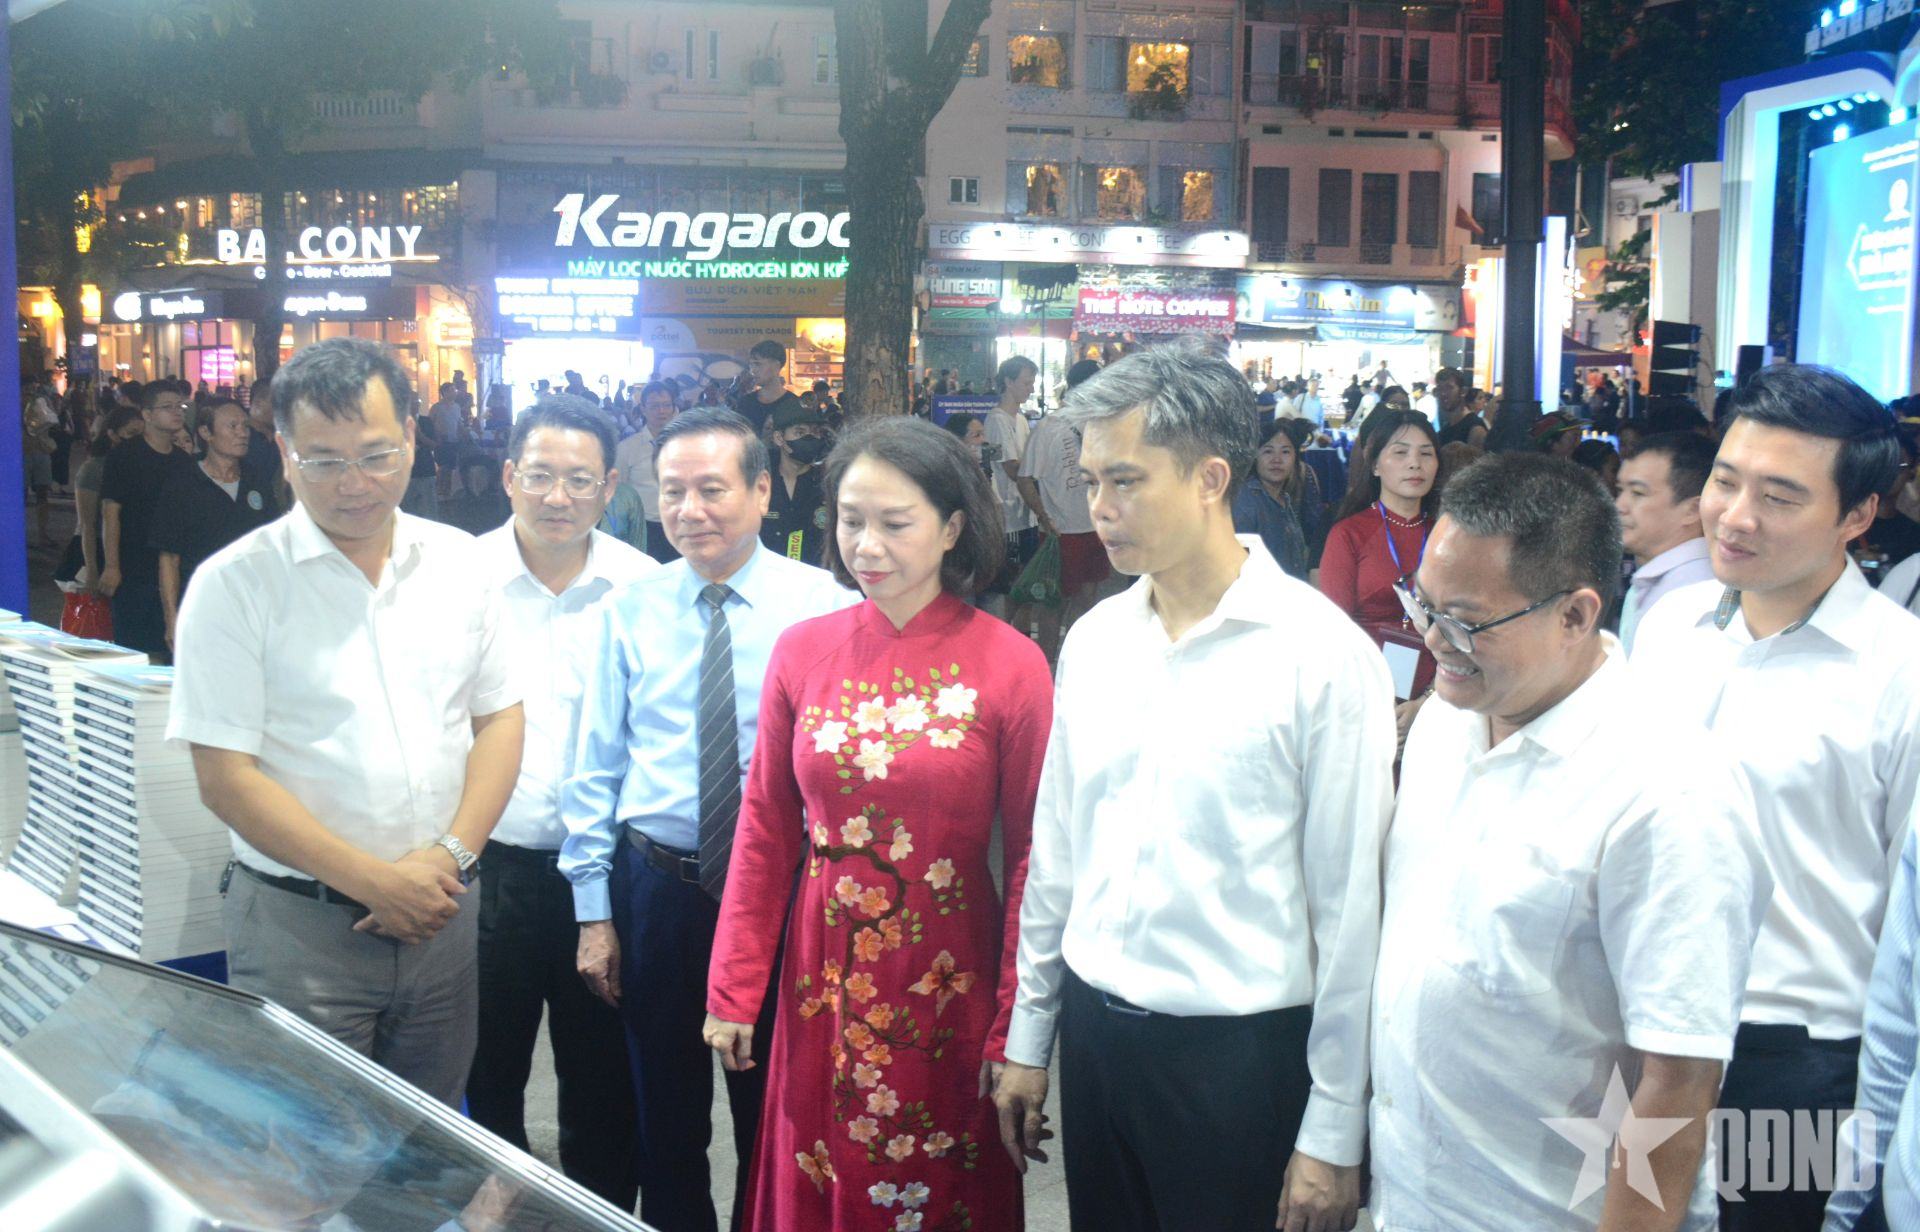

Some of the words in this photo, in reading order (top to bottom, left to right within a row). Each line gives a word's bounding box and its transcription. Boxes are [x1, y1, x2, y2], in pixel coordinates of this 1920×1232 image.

[217, 226, 422, 262] BACONY
[940, 229, 971, 245] EGG
[695, 261, 787, 279] HYDROGEN
[790, 261, 820, 278] ION
[787, 287, 817, 295] NAM
[1082, 298, 1117, 314] THE
[1118, 299, 1164, 315] NOTE
[1166, 299, 1230, 316] COFFEE
